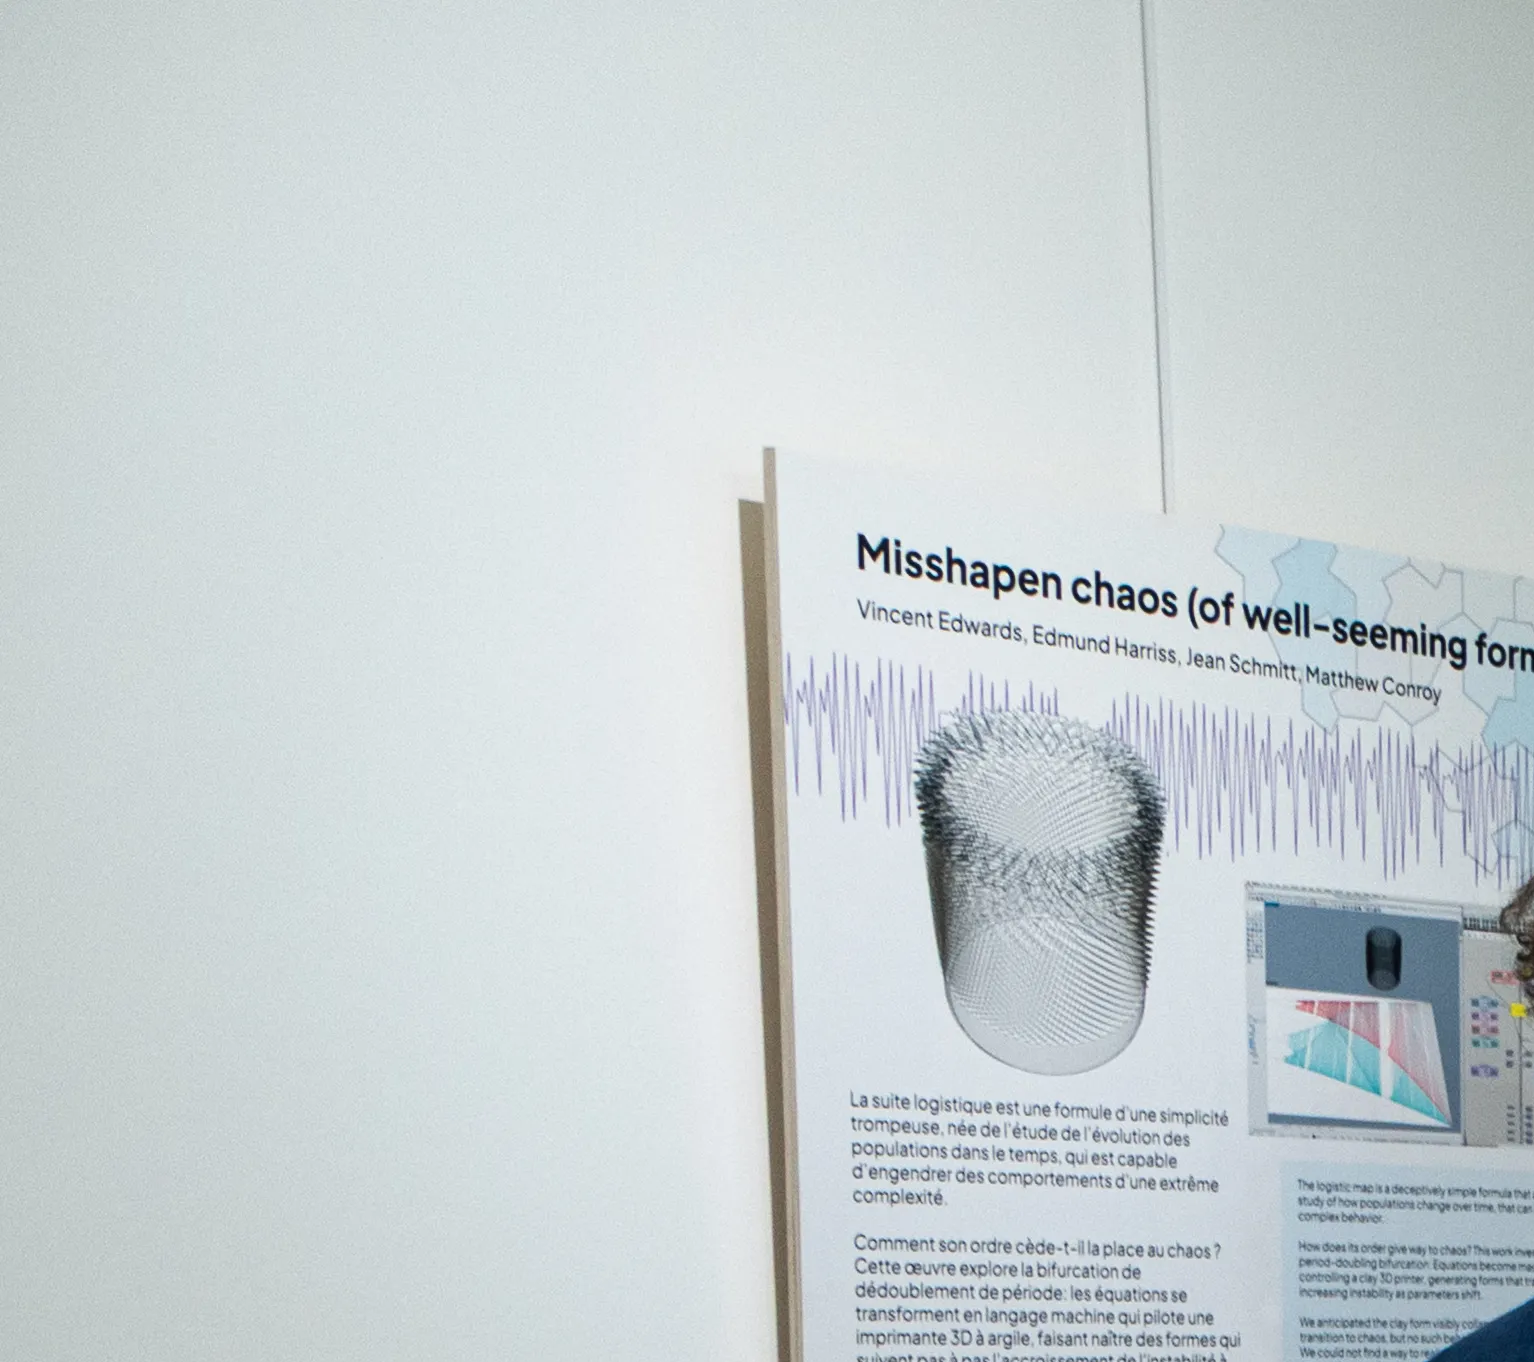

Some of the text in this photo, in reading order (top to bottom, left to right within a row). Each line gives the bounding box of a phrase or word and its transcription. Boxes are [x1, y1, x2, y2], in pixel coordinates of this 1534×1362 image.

[857, 533, 1062, 600] Misshapen
[1070, 570, 1178, 618] chaos
[1187, 587, 1234, 630] (of
[1241, 602, 1467, 671] well-seeming
[856, 599, 1442, 707] Vincent Edwards, Edmund Harriss, Jean Schmitt, Matthew Conroy
[849, 1090, 868, 1107] La
[871, 1091, 911, 1109] suite
[913, 1093, 993, 1117] logistique
[995, 1098, 1020, 1115] est
[1022, 1103, 1051, 1117] une
[1053, 1101, 1112, 1120] formule
[1159, 1106, 1229, 1129] simplicité
[947, 1118, 977, 1136] née
[979, 1120, 1001, 1137] de
[1060, 1124, 1081, 1141] de
[1162, 1129, 1190, 1146] des
[851, 1138, 948, 1162] populations
[950, 1142, 989, 1160] dans
[991, 1144, 1005, 1161] le
[1064, 1147, 1088, 1168] qui
[1090, 1148, 1114, 1166] est
[1117, 1150, 1177, 1172] capable
[954, 1166, 985, 1183] des
[987, 1167, 1112, 1191] comportements
[1159, 1173, 1219, 1192] extrême
[853, 1233, 935, 1251] Comment
[938, 1239, 967, 1252] son
[969, 1236, 1012, 1253] ordre
[1015, 1237, 1086, 1255] cède-t-il
[1086, 1239, 1100, 1256] la
[1102, 1239, 1144, 1260] place
[1147, 1245, 1164, 1257] au
[1166, 1241, 1211, 1258] chaos
[854, 1257, 1141, 1280] Cette œuvre explore la bifurcation de
[854, 1281, 975, 1299] dédoublement
[977, 1283, 999, 1299] de
[1070, 1284, 1091, 1301] les
[1093, 1285, 1168, 1305] équations
[1170, 1290, 1187, 1302] se
[854, 1304, 1214, 1328] transforment en langage machine qui pilote une
[855, 1327, 947, 1348] imprimante
[949, 1328, 973, 1345] 3D
[975, 1329, 984, 1345] à
[1036, 1329, 1088, 1346] faisant
[1090, 1330, 1132, 1346] naître
[1135, 1330, 1163, 1346] des
[1165, 1330, 1216, 1347] formes
[1218, 1331, 1241, 1350] qui
